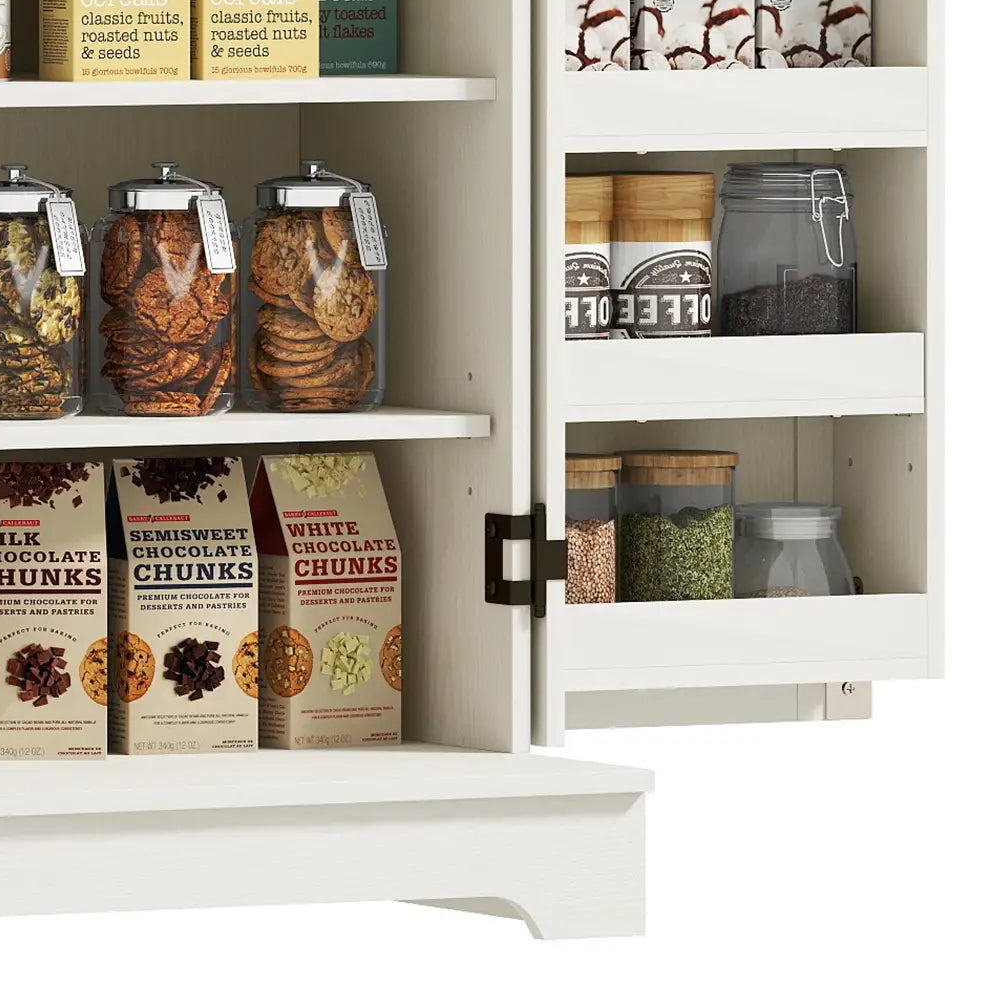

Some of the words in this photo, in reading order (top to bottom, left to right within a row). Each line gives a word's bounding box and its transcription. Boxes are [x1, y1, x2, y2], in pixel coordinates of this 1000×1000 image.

[81, 11, 133, 25] classic
[137, 10, 184, 27] fruits,
[211, 9, 262, 24] classic
[267, 9, 312, 26] fruits,
[334, 7, 386, 20] toasted
[81, 29, 140, 42] roasted
[143, 29, 178, 42] nuts
[211, 28, 268, 41] roasted
[272, 28, 307, 40] nuts
[333, 25, 374, 38] flakes
[82, 46, 94, 59] &
[98, 46, 140, 59] seeds
[211, 45, 223, 58] &
[228, 45, 269, 58] seeds
[92, 68, 123, 76] glorious
[160, 67, 178, 75] 700g
[221, 64, 252, 76] glorious
[289, 64, 307, 75] 700g
[130, 529, 248, 542] SEMISWEET
[286, 522, 359, 537] WHITE
[133, 545, 252, 559] CHOCOLATE
[292, 540, 396, 554] CHOCOLATE
[135, 562, 253, 581] CHUNKS
[295, 557, 398, 577] CHUNKS
[297, 588, 333, 596] PREMIUM
[300, 598, 338, 606] DESSERTS
[0, 627, 30, 643] PERFECT
[1, 748, 17, 756] 340g
[134, 742, 145, 750] NET
[147, 742, 157, 750] WT
